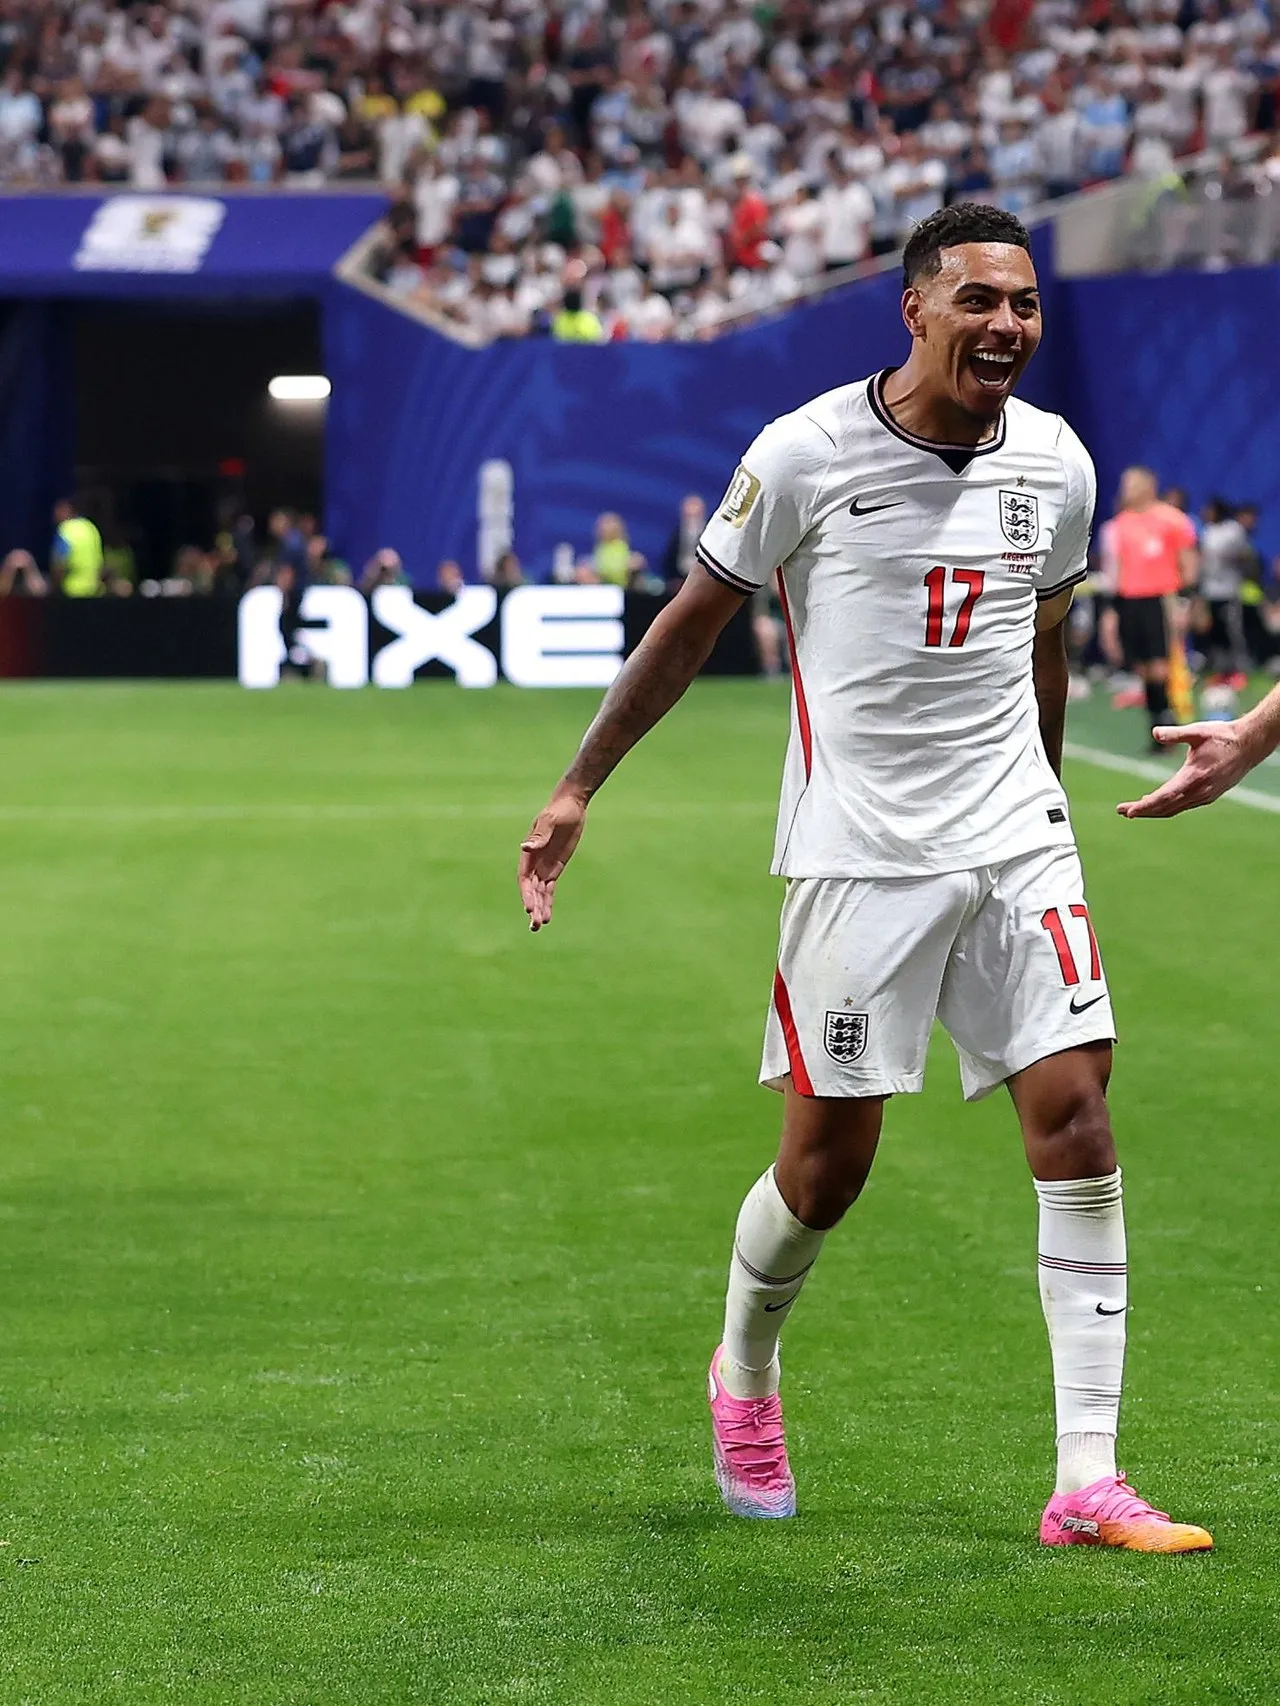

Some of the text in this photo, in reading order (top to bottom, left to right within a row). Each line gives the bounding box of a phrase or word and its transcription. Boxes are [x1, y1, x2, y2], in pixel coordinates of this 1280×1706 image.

[238, 584, 626, 688] AXE
[924, 566, 985, 647] 17
[1041, 904, 1101, 986] 17
